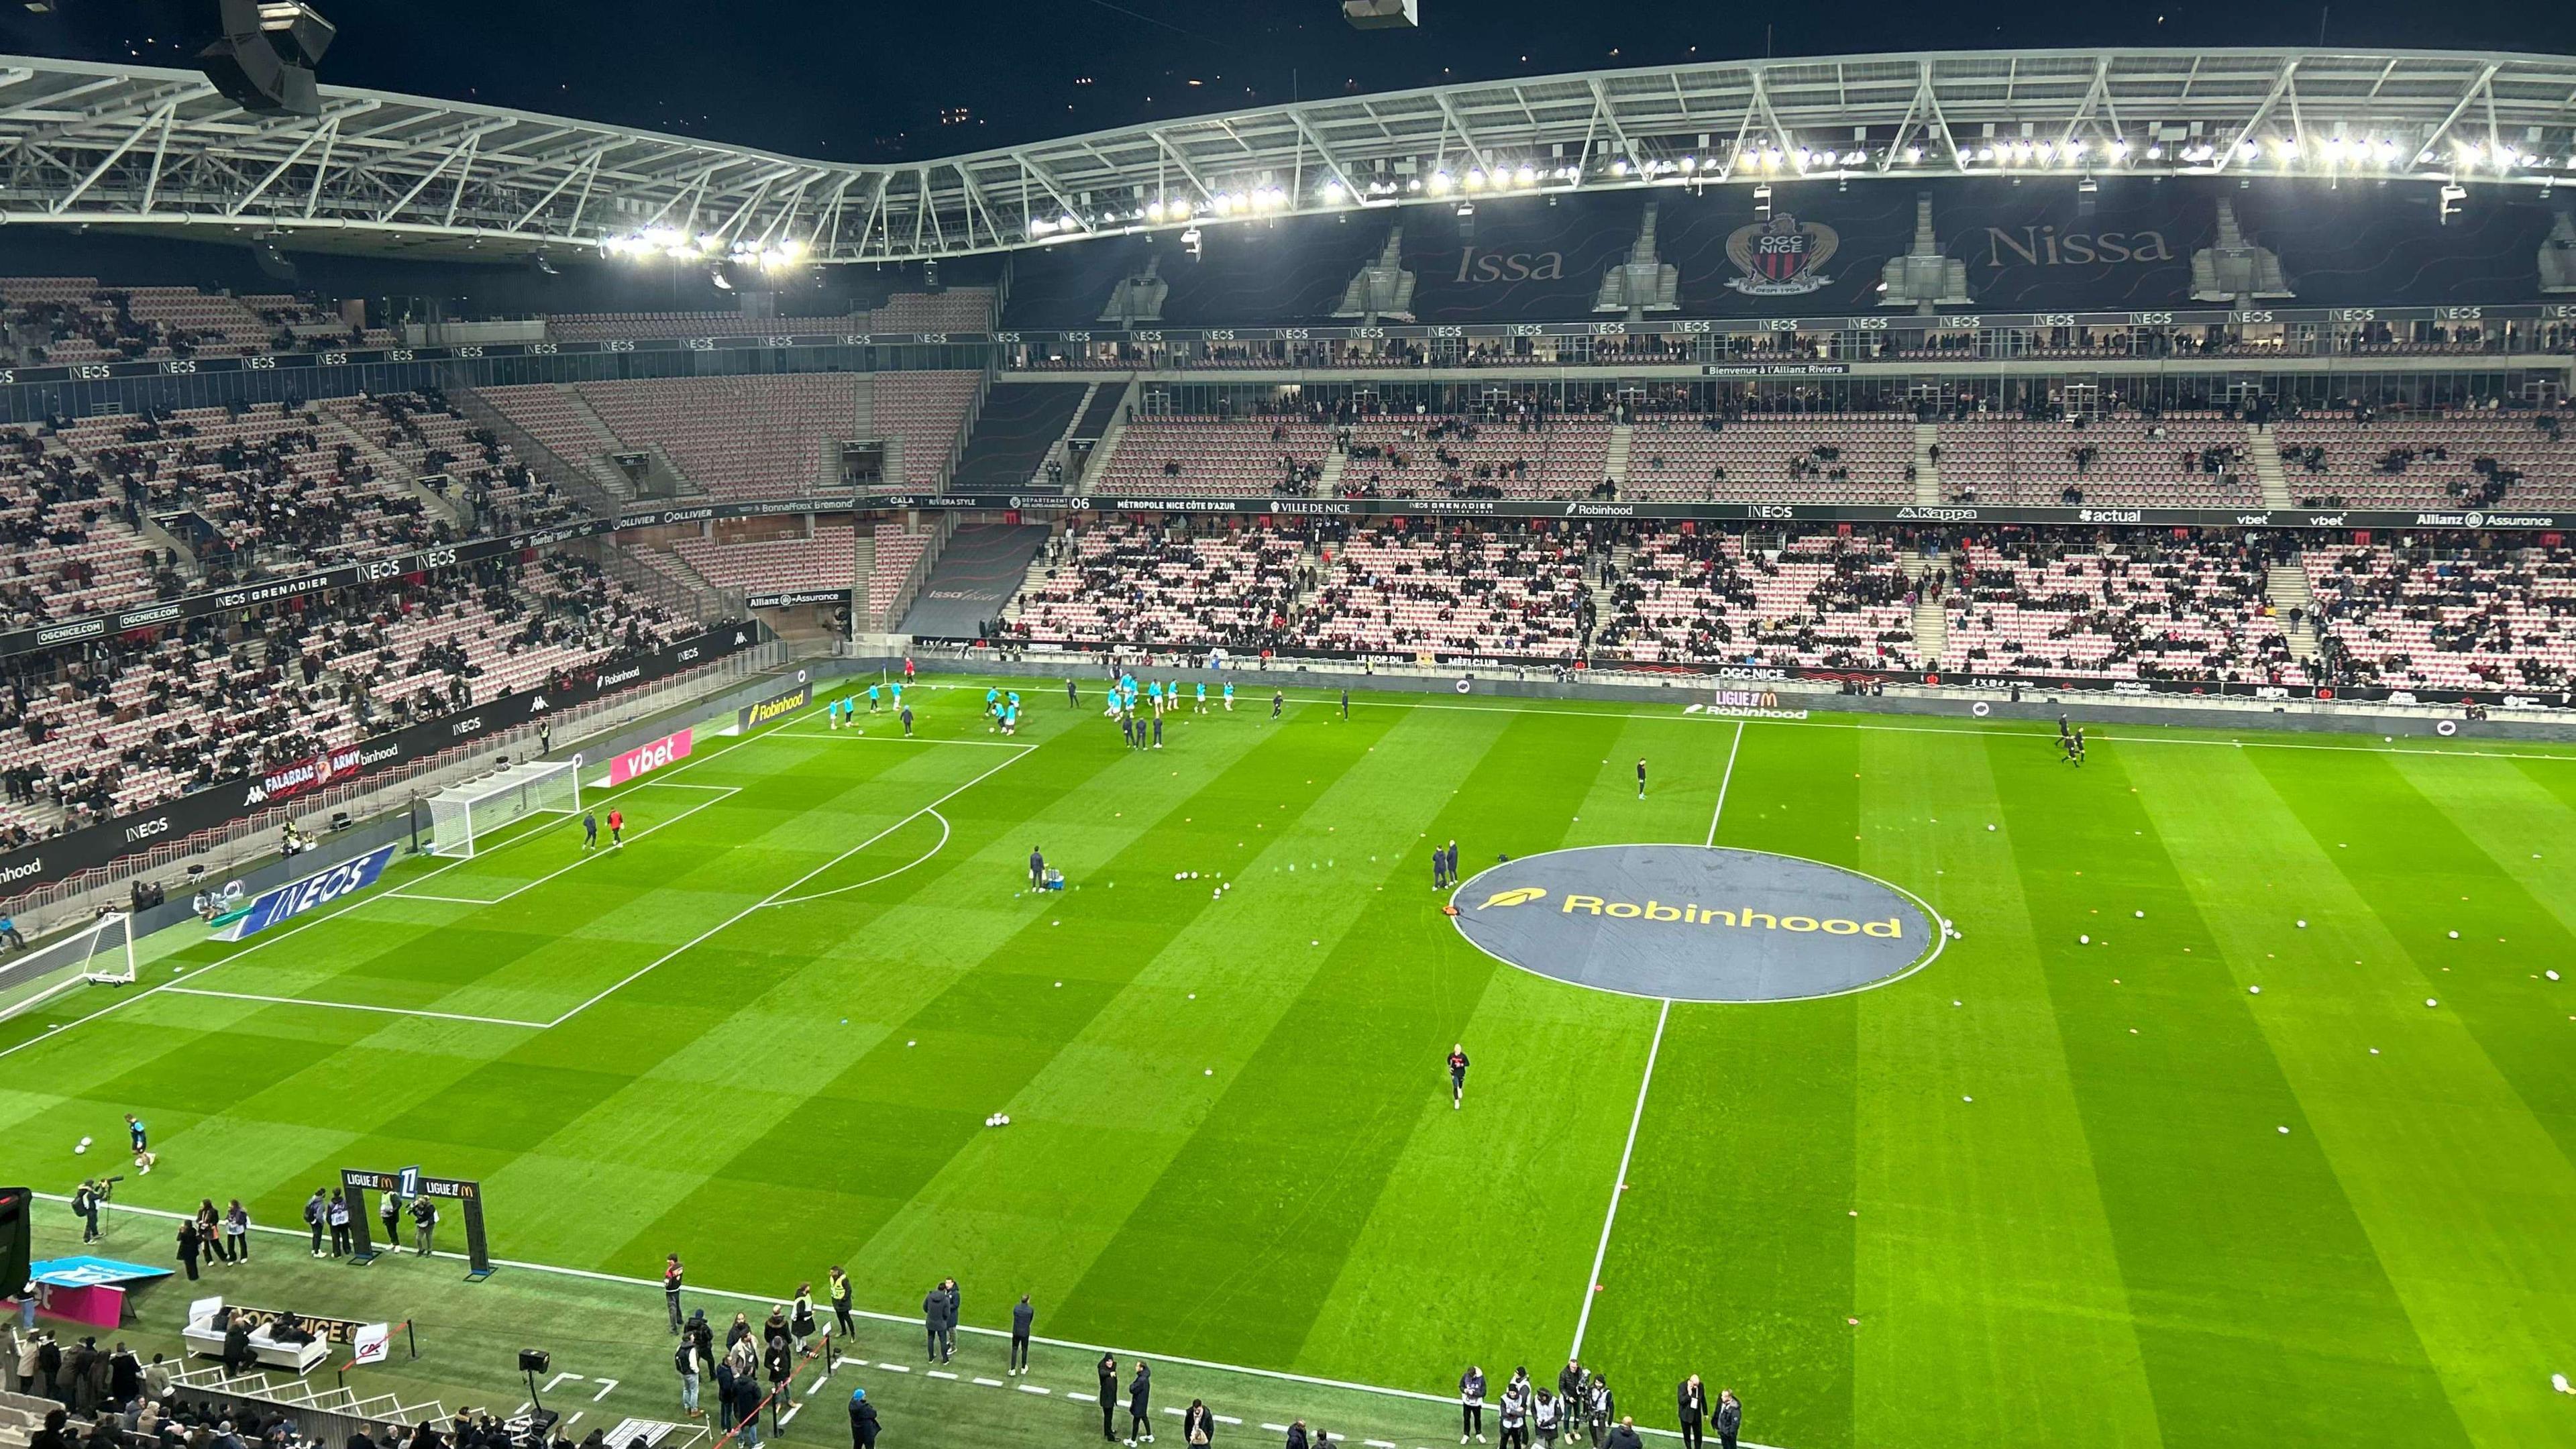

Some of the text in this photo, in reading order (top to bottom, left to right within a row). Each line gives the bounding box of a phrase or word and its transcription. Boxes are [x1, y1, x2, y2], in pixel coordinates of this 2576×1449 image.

[1760, 235, 1803, 246] OGC
[1984, 225, 2174, 266] Nissa
[1759, 245, 1803, 254] NICE
[1452, 246, 1564, 282] Issa
[2228, 311, 2273, 323] INEOS
[2328, 309, 2375, 321] INEOS
[2434, 308, 2481, 320] INEOS
[2542, 306, 2576, 318] INEO
[1848, 319, 1888, 329] INEOS
[1939, 317, 1980, 327] INEOS
[2033, 315, 2075, 325] INEOS
[2129, 313, 2172, 324] INEOS
[1507, 325, 1542, 335] INEOS
[1589, 323, 1625, 334] INEOS
[1672, 322, 1710, 333] INEOS
[1759, 320, 1798, 331] INEOS
[989, 333, 1020, 343] INEOS
[1059, 332, 1090, 341] INEOS
[1130, 331, 1162, 341] INEOS
[1202, 330, 1234, 340] INEOS
[1276, 329, 1308, 339] INEOS
[1350, 328, 1384, 337] INEOS
[1428, 327, 1462, 337] INEOS
[679, 338, 713, 349] INEOS
[758, 337, 792, 347] INEOS
[837, 335, 871, 345] INEOS
[913, 334, 947, 343] INEOS
[451, 347, 482, 358] INEOS
[525, 343, 557, 355] INEOS
[600, 341, 635, 352] INEOS
[316, 353, 347, 365] INEOS
[384, 350, 413, 362] INEOS
[158, 361, 196, 375] INEOS
[241, 357, 275, 370] INEOS
[69, 365, 110, 380] INEOS
[1709, 365, 1843, 375] Bienvenue à l'Allianz Riviera
[890, 496, 914, 504] CALA
[1071, 497, 1090, 509] 06
[1117, 499, 1236, 510] MÉTROPOLE NICE CÔTE D'AZUR
[1281, 502, 1350, 513] VILLE DE NICE
[1578, 504, 1633, 515] Robinhood
[1748, 505, 1793, 518] INEOS
[674, 509, 712, 521] OLLIVIER
[1918, 507, 1977, 521] Kappa
[2092, 509, 2141, 523] actual
[2237, 515, 2268, 525] vbet
[2416, 514, 2553, 526] Allianz Assurance
[621, 515, 655, 527] OLLIVIER
[2310, 516, 2344, 526] vbet
[416, 548, 456, 570] INEOS
[356, 559, 400, 583] INEOS
[215, 577, 328, 608] INEOS GRENADIER
[750, 598, 780, 607] Allianz
[123, 607, 178, 625] OGCNICE.COM
[40, 623, 101, 641] OGCNICE.COM
[678, 647, 699, 662] INEOS
[604, 665, 640, 686] Robinhood
[1720, 667, 1785, 680] OGC NICE
[1716, 690, 1750, 706] LIGUE
[759, 689, 804, 721] Robinhood
[1706, 705, 1808, 720] Robinhood
[452, 716, 481, 736] INEOS
[361, 743, 398, 766] binhood
[627, 736, 674, 777] vbet
[265, 749, 362, 793] FALABRAC ARMY
[125, 816, 168, 843] INEOS
[0, 857, 42, 885] nhood
[263, 856, 371, 927] INEOS
[1562, 894, 1902, 938] Robinhood
[347, 1173, 370, 1186] LIGUE
[426, 1181, 451, 1195] LIGUE
